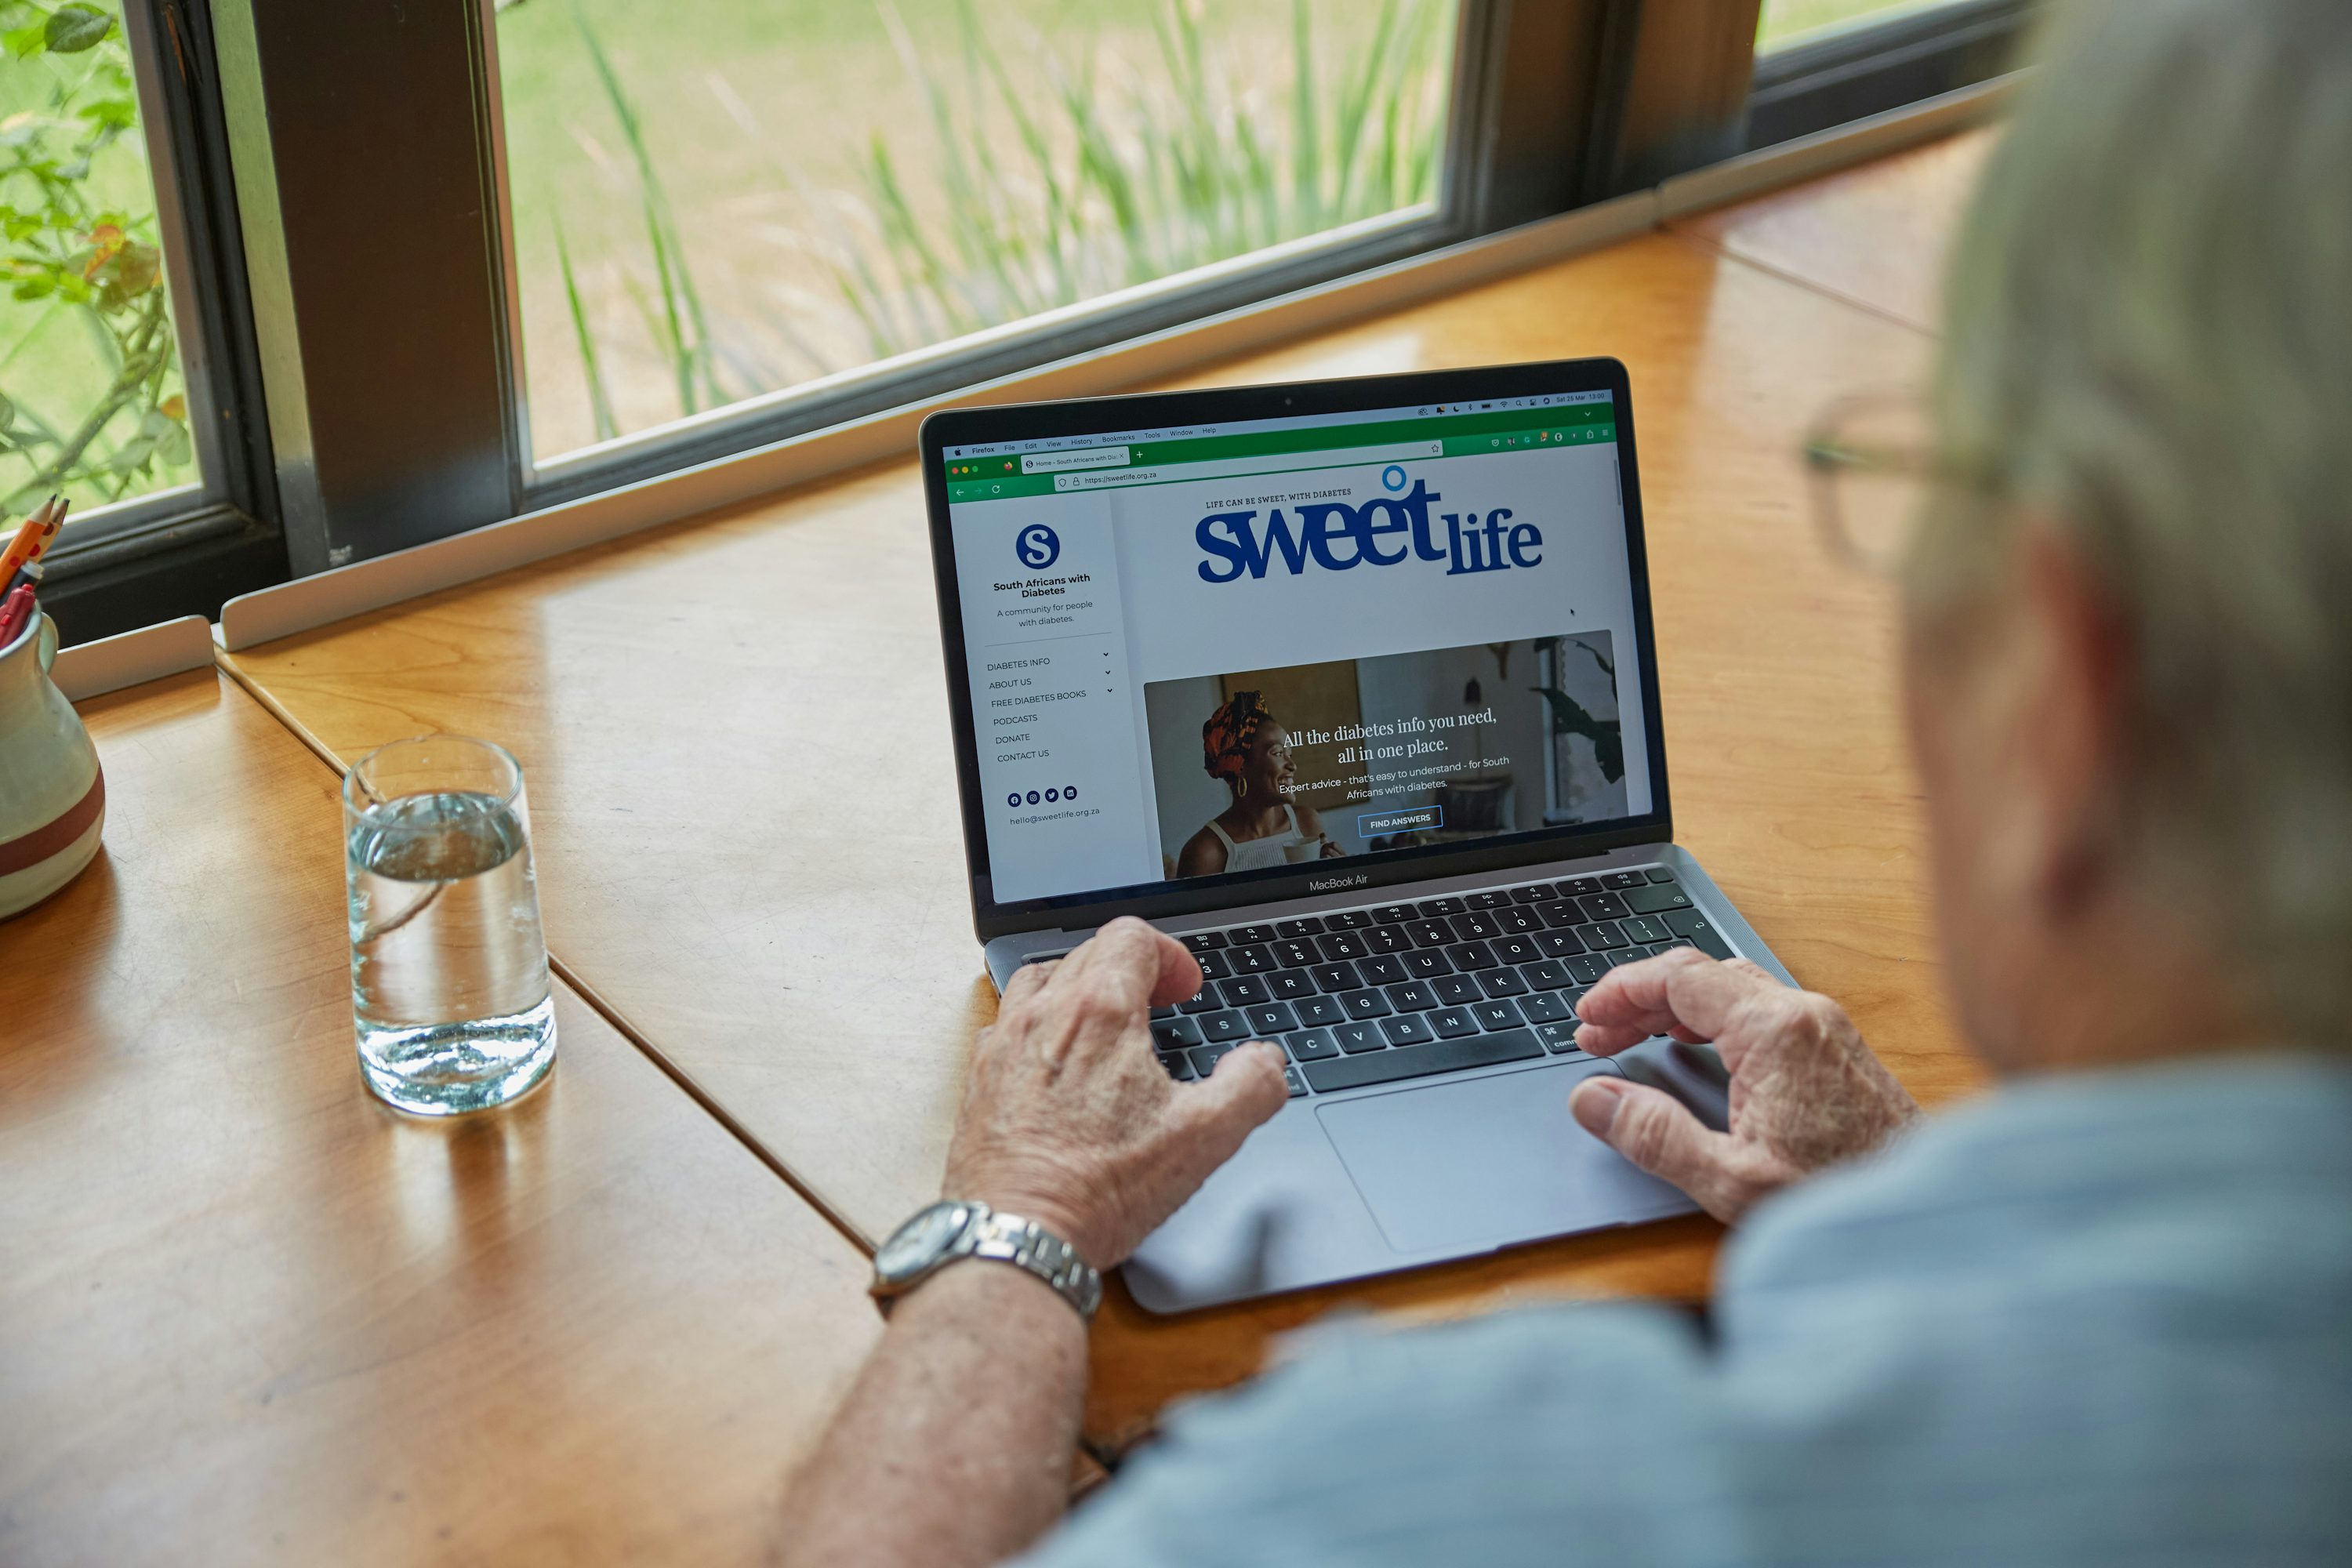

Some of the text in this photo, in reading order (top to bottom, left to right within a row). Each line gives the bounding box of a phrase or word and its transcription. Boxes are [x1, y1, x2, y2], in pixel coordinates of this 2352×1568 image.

[1102, 434, 1135, 443] Bookmarks
[1084, 471, 1156, 485] https://sweetlife.org.za
[1258, 495, 1287, 504] SWEET,
[1313, 488, 1352, 499] DIABETES
[1195, 478, 1543, 584] sweet life
[993, 573, 1091, 591] South Africans with
[1022, 587, 1065, 598] Diabetes
[1004, 605, 1051, 616] community
[1065, 601, 1093, 612] people
[1038, 615, 1074, 625] diabetes.
[987, 658, 1051, 671] DIABETES INFO
[989, 680, 1019, 689] ABOUT
[991, 690, 1087, 708] FREE DIABETES BOOKS
[993, 714, 1038, 726] PODCASTS
[1283, 708, 1497, 749] All the diabetes info you need,
[995, 733, 1031, 745] DONATE
[1338, 739, 1449, 764] all in one place.
[997, 751, 1036, 763] CONTACT
[1279, 782, 1310, 795] Expert
[1312, 778, 1341, 790] advice
[1348, 773, 1374, 786] that's
[1376, 771, 1396, 782] easy
[1398, 770, 1407, 779] to
[1409, 761, 1461, 777] understand
[1468, 759, 1481, 770] for
[1483, 756, 1510, 768] South
[1346, 779, 1448, 800] Africans with diabetes.
[1010, 808, 1100, 826] hello@sweetlife.org.za
[1370, 813, 1431, 829] FIND ANSWERS
[1309, 874, 1368, 891] MacBook Air
[1340, 945, 1349, 953] 6
[1295, 952, 1304, 960] 5
[1421, 958, 1432, 967] U
[1202, 965, 1212, 974] 3
[1285, 979, 1296, 988] R
[1495, 978, 1507, 986] K
[1238, 986, 1249, 995] E
[1405, 992, 1417, 1000] H
[1359, 999, 1370, 1007] G
[1313, 1006, 1322, 1014] F
[1492, 1010, 1505, 1019] M
[1265, 1014, 1276, 1022] D
[1446, 1017, 1458, 1026] N
[1219, 1021, 1229, 1029] S
[1400, 1025, 1412, 1034] B
[1352, 1032, 1363, 1040] V
[1306, 1040, 1317, 1049] C
